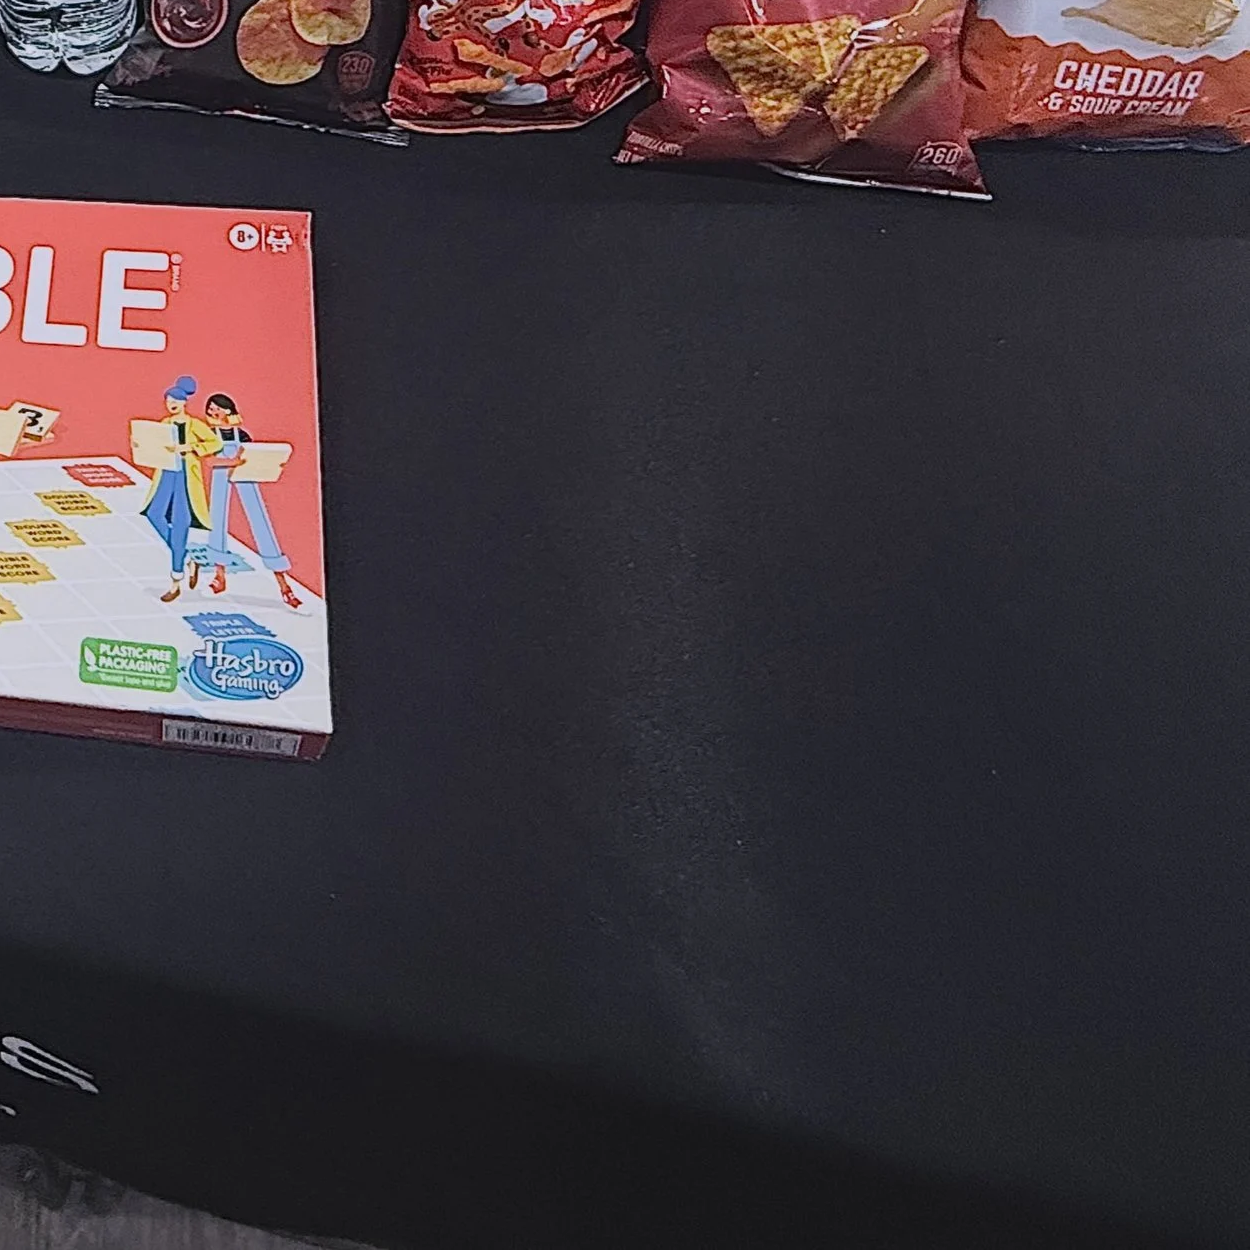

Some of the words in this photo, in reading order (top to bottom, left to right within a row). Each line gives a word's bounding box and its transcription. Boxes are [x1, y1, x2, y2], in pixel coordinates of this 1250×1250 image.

[341, 58, 370, 73] 230
[1053, 60, 1204, 100] CHEDDAR
[1048, 92, 1064, 111] &
[1068, 94, 1123, 116] SOUR
[1124, 100, 1192, 117] CREAM
[918, 147, 959, 165] 260
[236, 230, 254, 243] 8+
[99, 643, 172, 662] PLASTIC-FREE
[193, 637, 296, 677] Hasbro
[211, 668, 284, 700] Gaming
